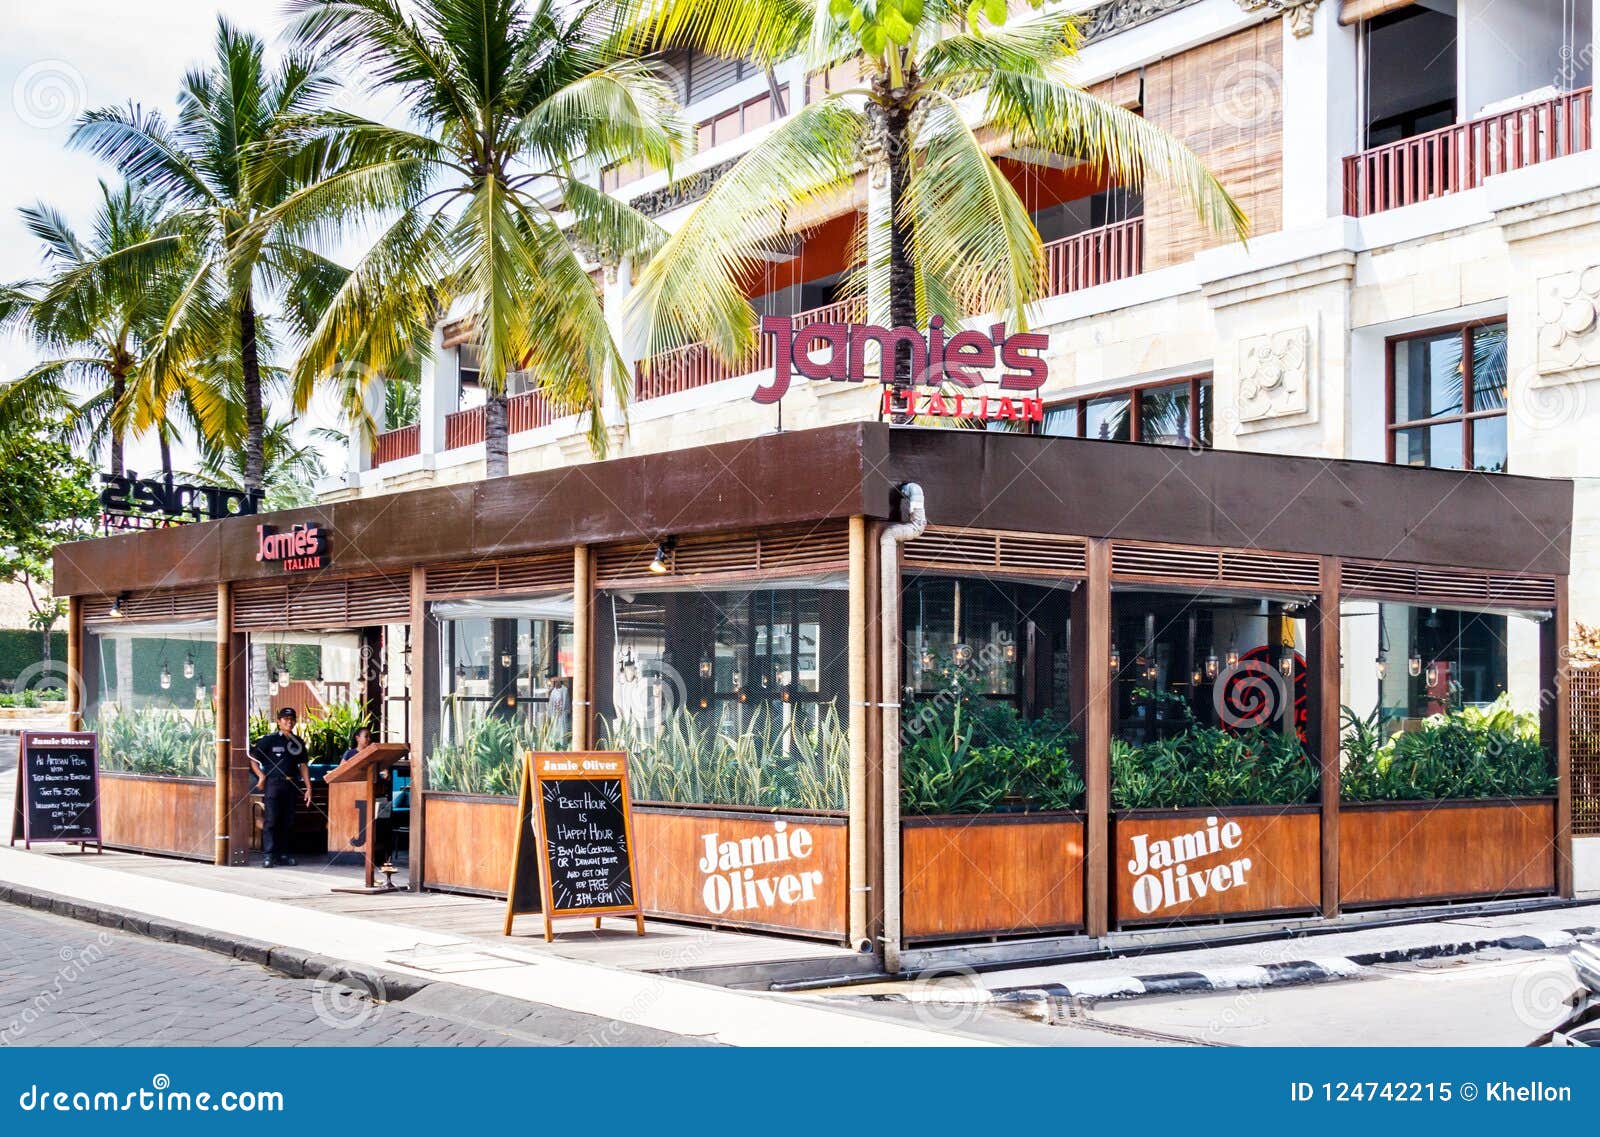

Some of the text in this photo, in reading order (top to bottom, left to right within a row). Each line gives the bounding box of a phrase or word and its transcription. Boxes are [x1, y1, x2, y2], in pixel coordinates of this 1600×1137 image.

[751, 314, 1049, 404] Jamie's
[882, 390, 1043, 421] ITALIAN
[256, 523, 318, 562] Jamie's
[284, 556, 320, 571] ITALIAN
[32, 737, 91, 745] Jamie Oliver
[543, 760, 618, 771] Jamie Oliver
[558, 792, 607, 810] BEST HOUR
[350, 800, 367, 847] J
[579, 813, 588, 823] IS
[557, 823, 613, 840] HAPPY HOUR
[587, 843, 615, 854] COCKTAIL
[699, 820, 813, 874] Jamie
[1128, 816, 1242, 875] Jamie
[557, 859, 569, 867] OR
[582, 869, 593, 878] GET
[595, 868, 609, 876] ONE
[588, 878, 609, 891] FREE
[703, 868, 823, 914] Oliver
[1132, 857, 1252, 913] Oliver
